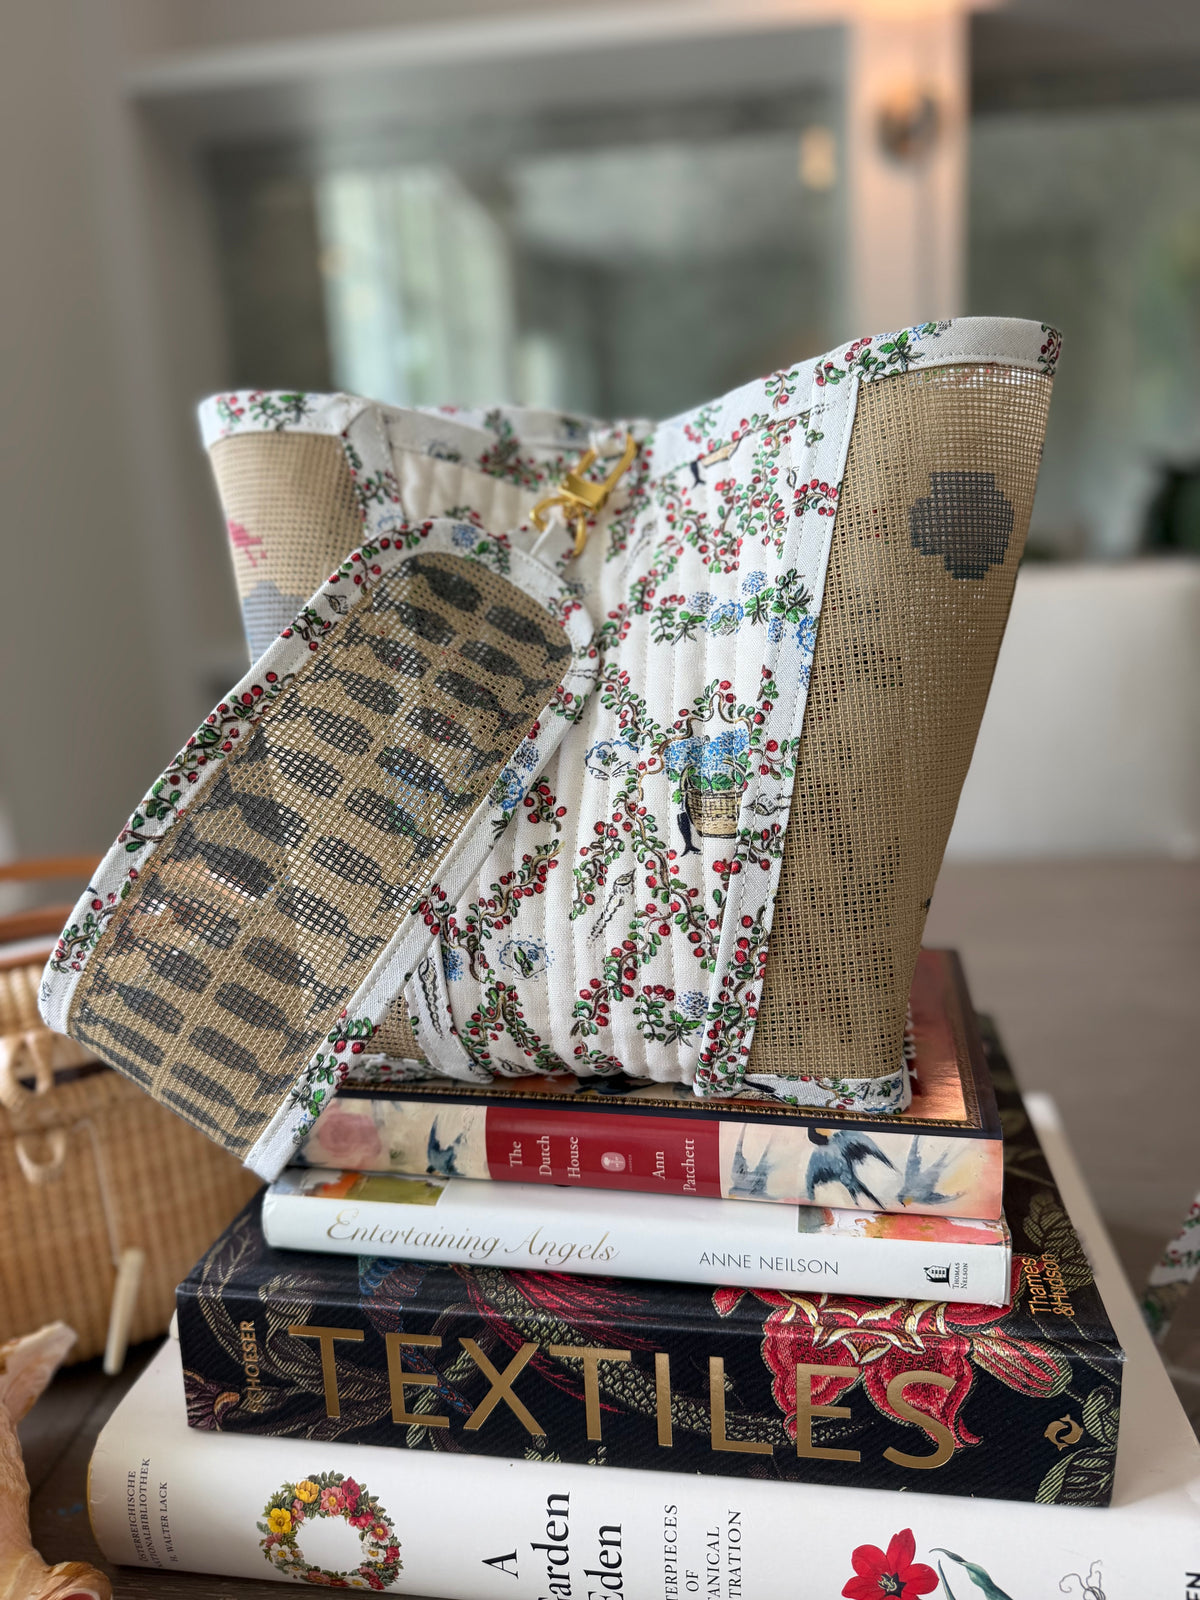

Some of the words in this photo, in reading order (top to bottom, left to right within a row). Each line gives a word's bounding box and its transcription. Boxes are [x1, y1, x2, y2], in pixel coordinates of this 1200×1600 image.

[509, 1141, 522, 1167] The
[537, 1135, 552, 1177] Dutch
[568, 1136, 581, 1179] House
[652, 1150, 666, 1180] Ann
[683, 1138, 697, 1192] Patchett
[326, 1208, 501, 1259] Entertaining
[504, 1226, 620, 1265] Angels
[699, 1251, 751, 1270] ANNE
[759, 1254, 839, 1276] NEILSON
[1022, 1257, 1051, 1314] Thames
[288, 1324, 959, 1470] TEXTILES
[159, 1482, 168, 1512] LACK
[160, 1515, 175, 1552] WALTER
[530, 1491, 571, 1600] arden
[481, 1549, 518, 1579] A
[686, 1569, 699, 1592] OF
[706, 1526, 720, 1600] ANICAL
